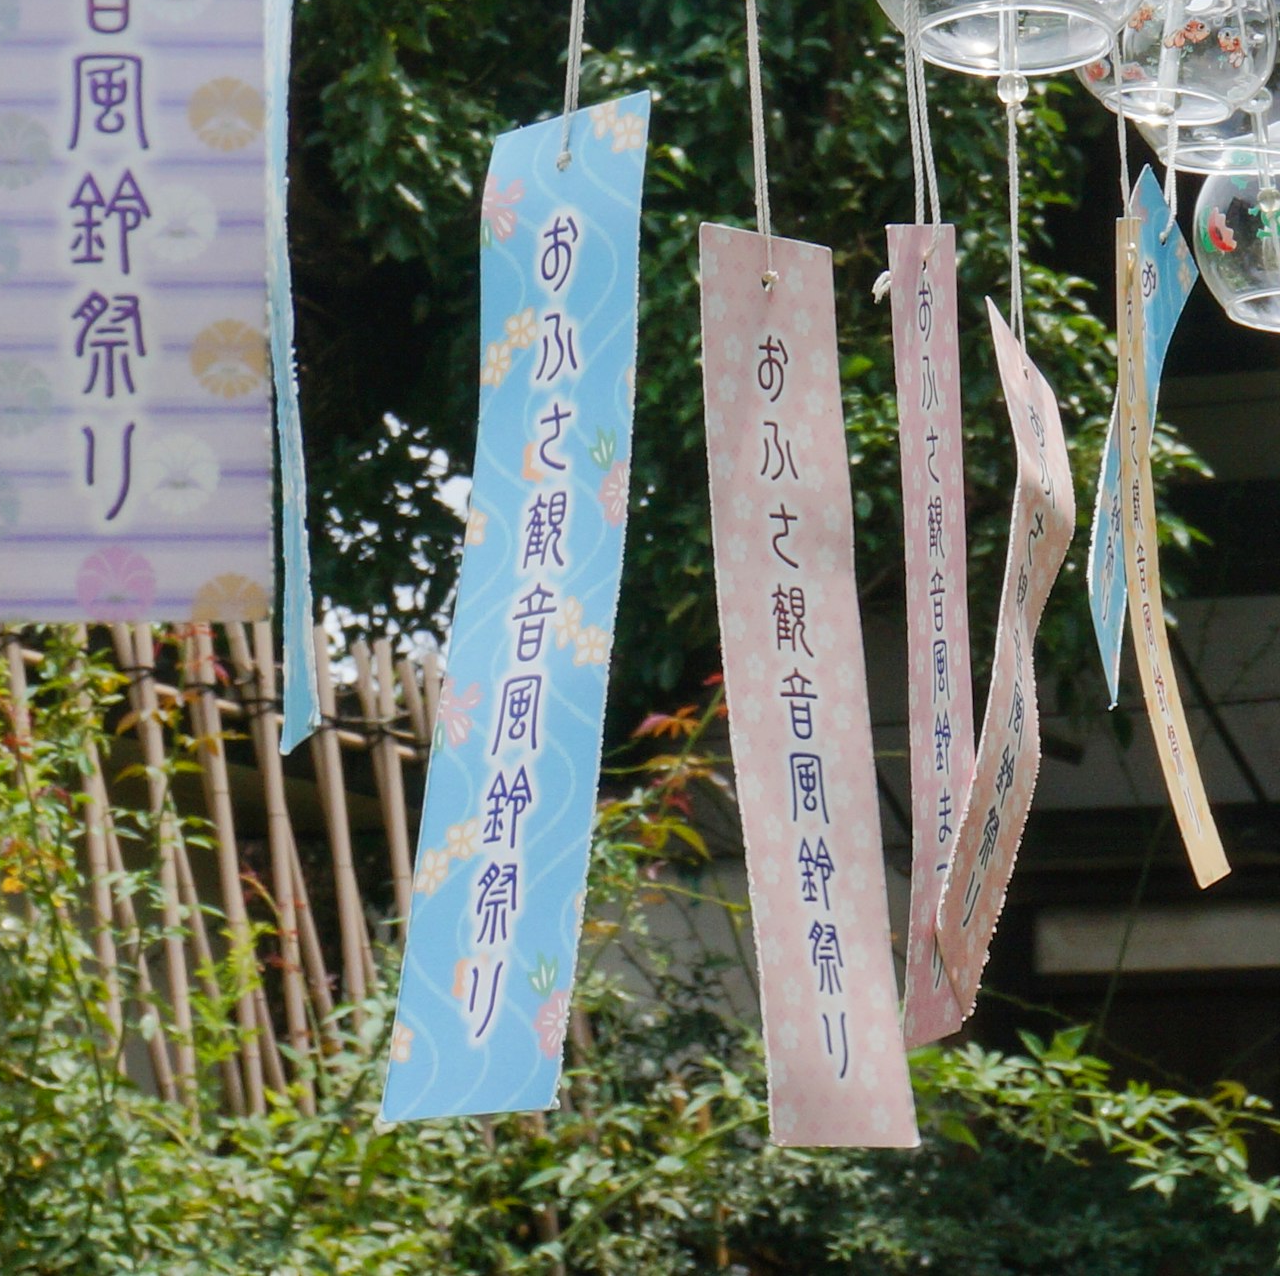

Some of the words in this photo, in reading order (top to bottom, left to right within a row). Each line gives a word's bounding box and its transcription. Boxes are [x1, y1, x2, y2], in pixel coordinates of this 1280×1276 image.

[463, 216, 581, 1040] おふさ観音風鈴祭り
[756, 333, 851, 1081] おふさ観音風鈴祭り
[916, 281, 955, 990] おふさ観音風鈴まり
